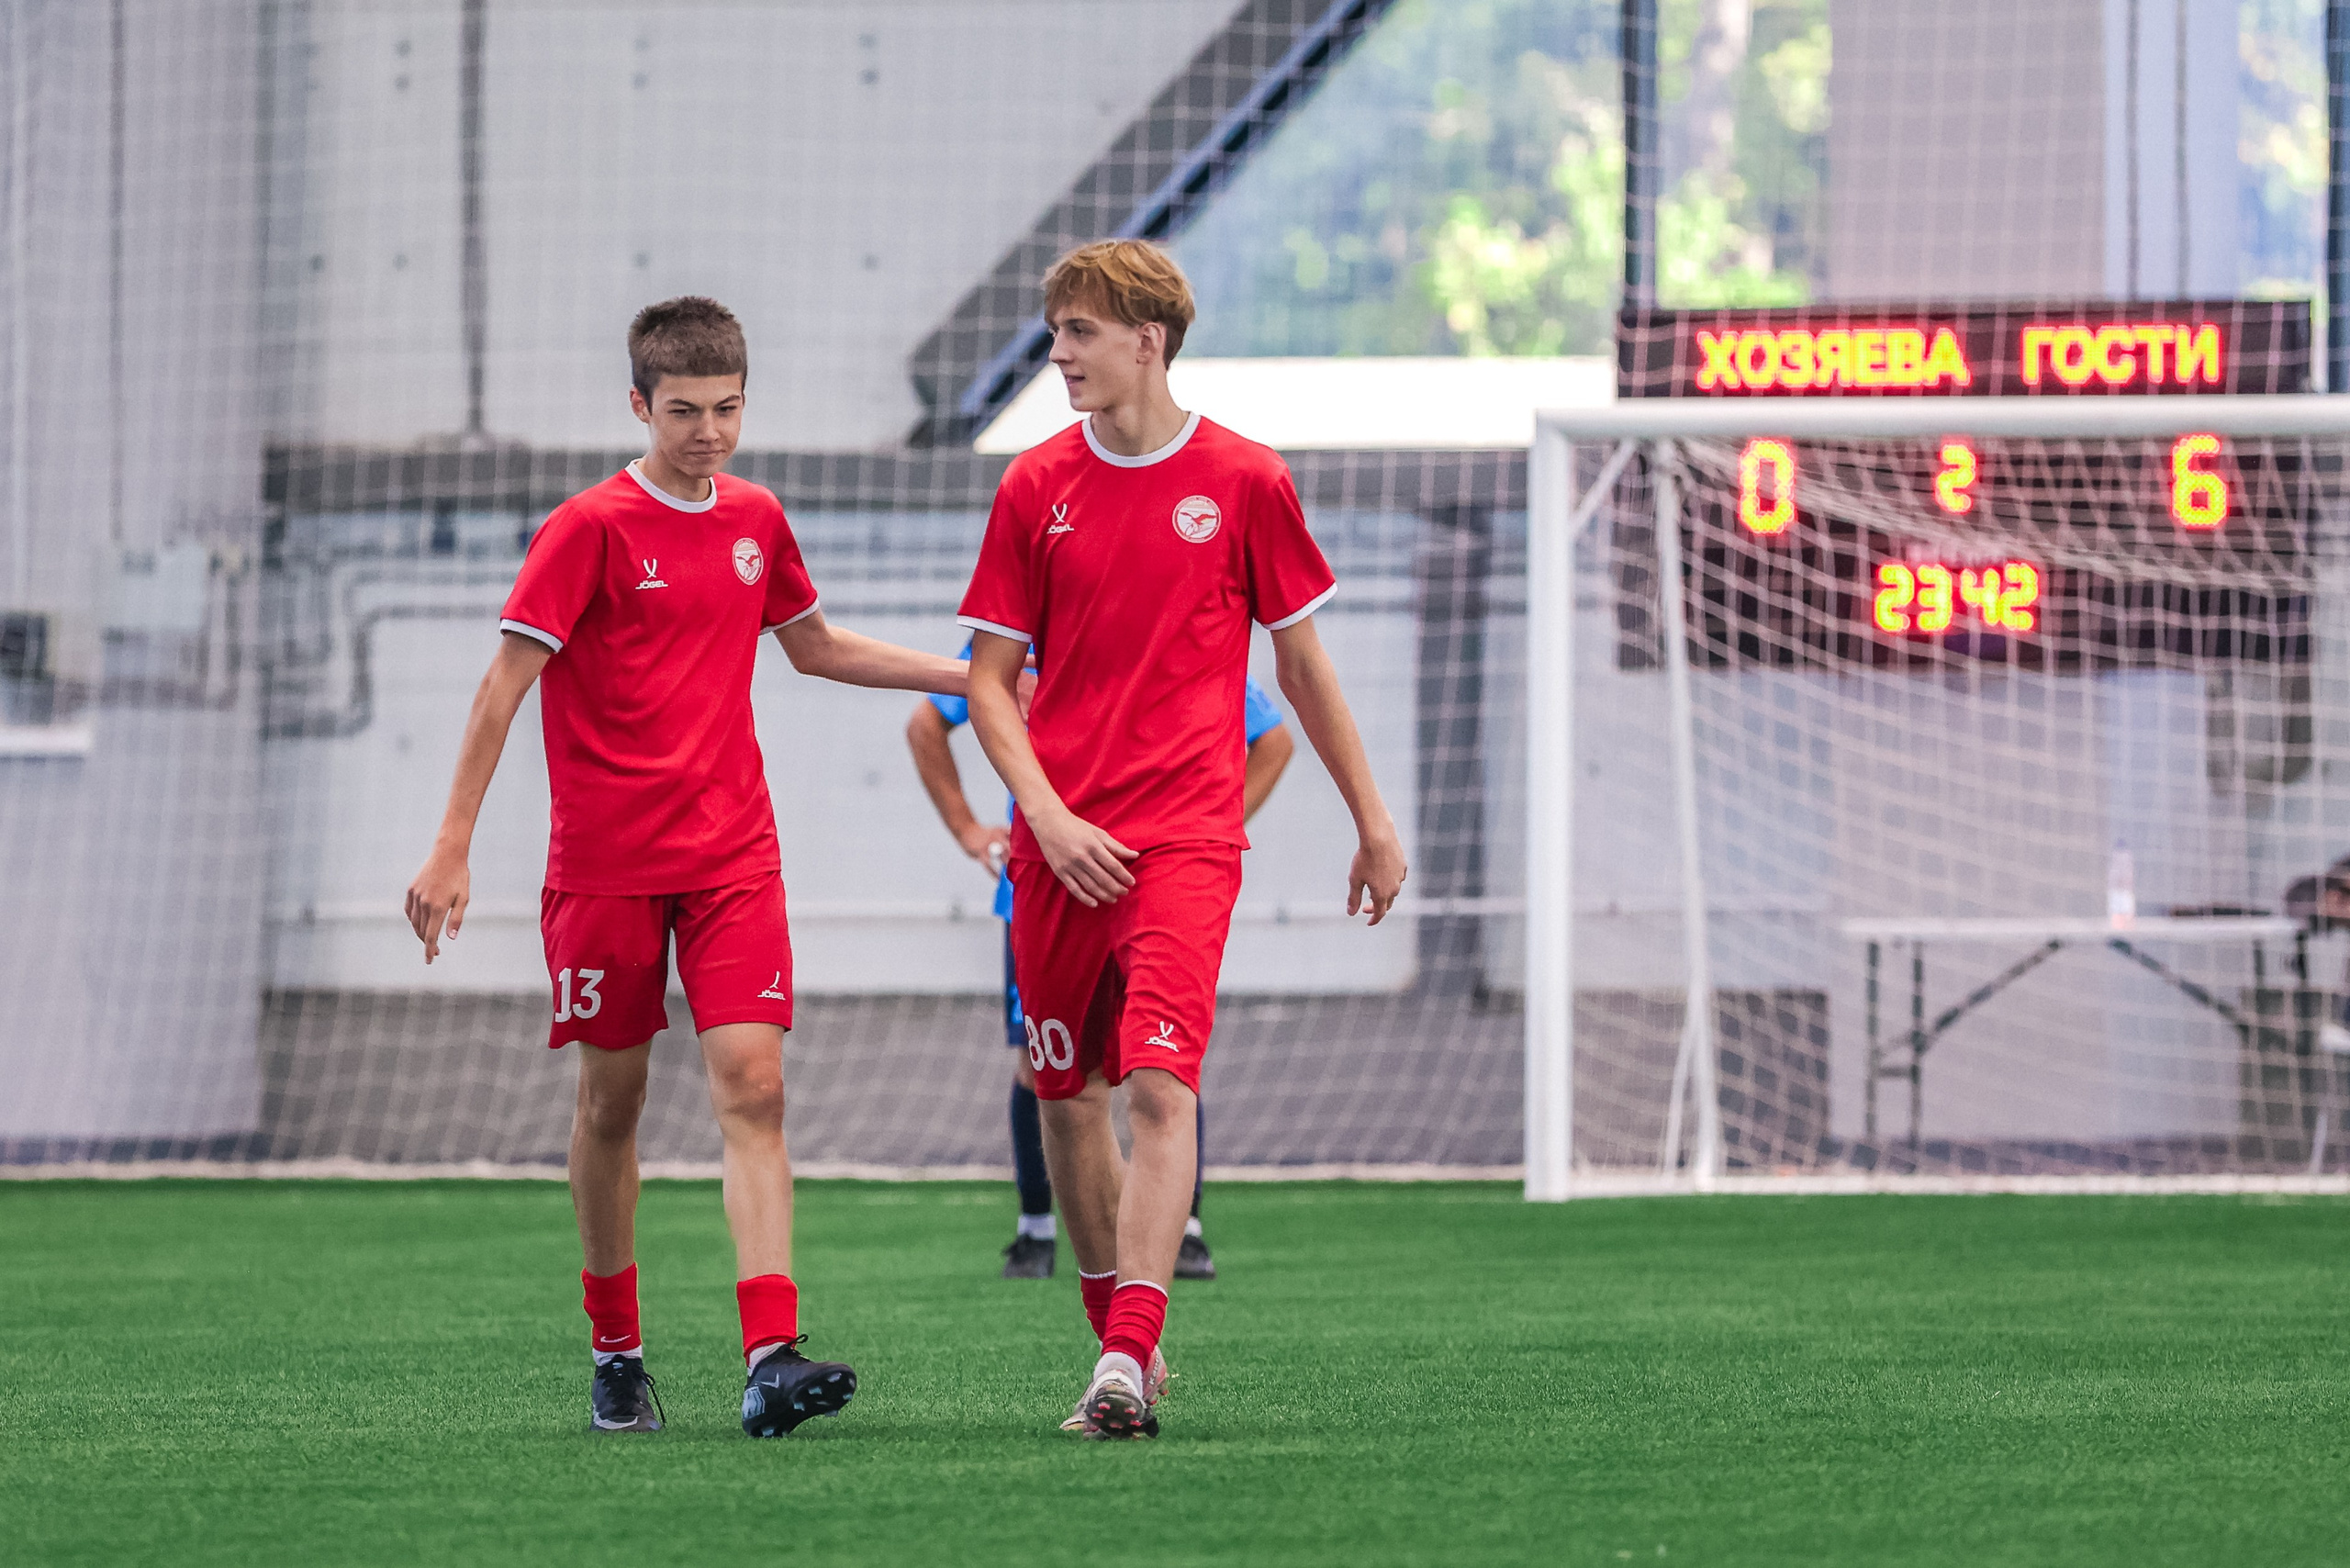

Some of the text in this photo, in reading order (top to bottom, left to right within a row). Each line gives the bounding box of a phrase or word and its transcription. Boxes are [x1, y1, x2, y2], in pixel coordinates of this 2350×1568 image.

[1697, 324, 2221, 389] ХОЗЯЕВА ГОСТИ
[1739, 433, 2229, 535] 0 2 6
[634, 579, 669, 590] JÖGEL
[554, 967, 605, 1023] 13
[1024, 1014, 1074, 1071] 80
